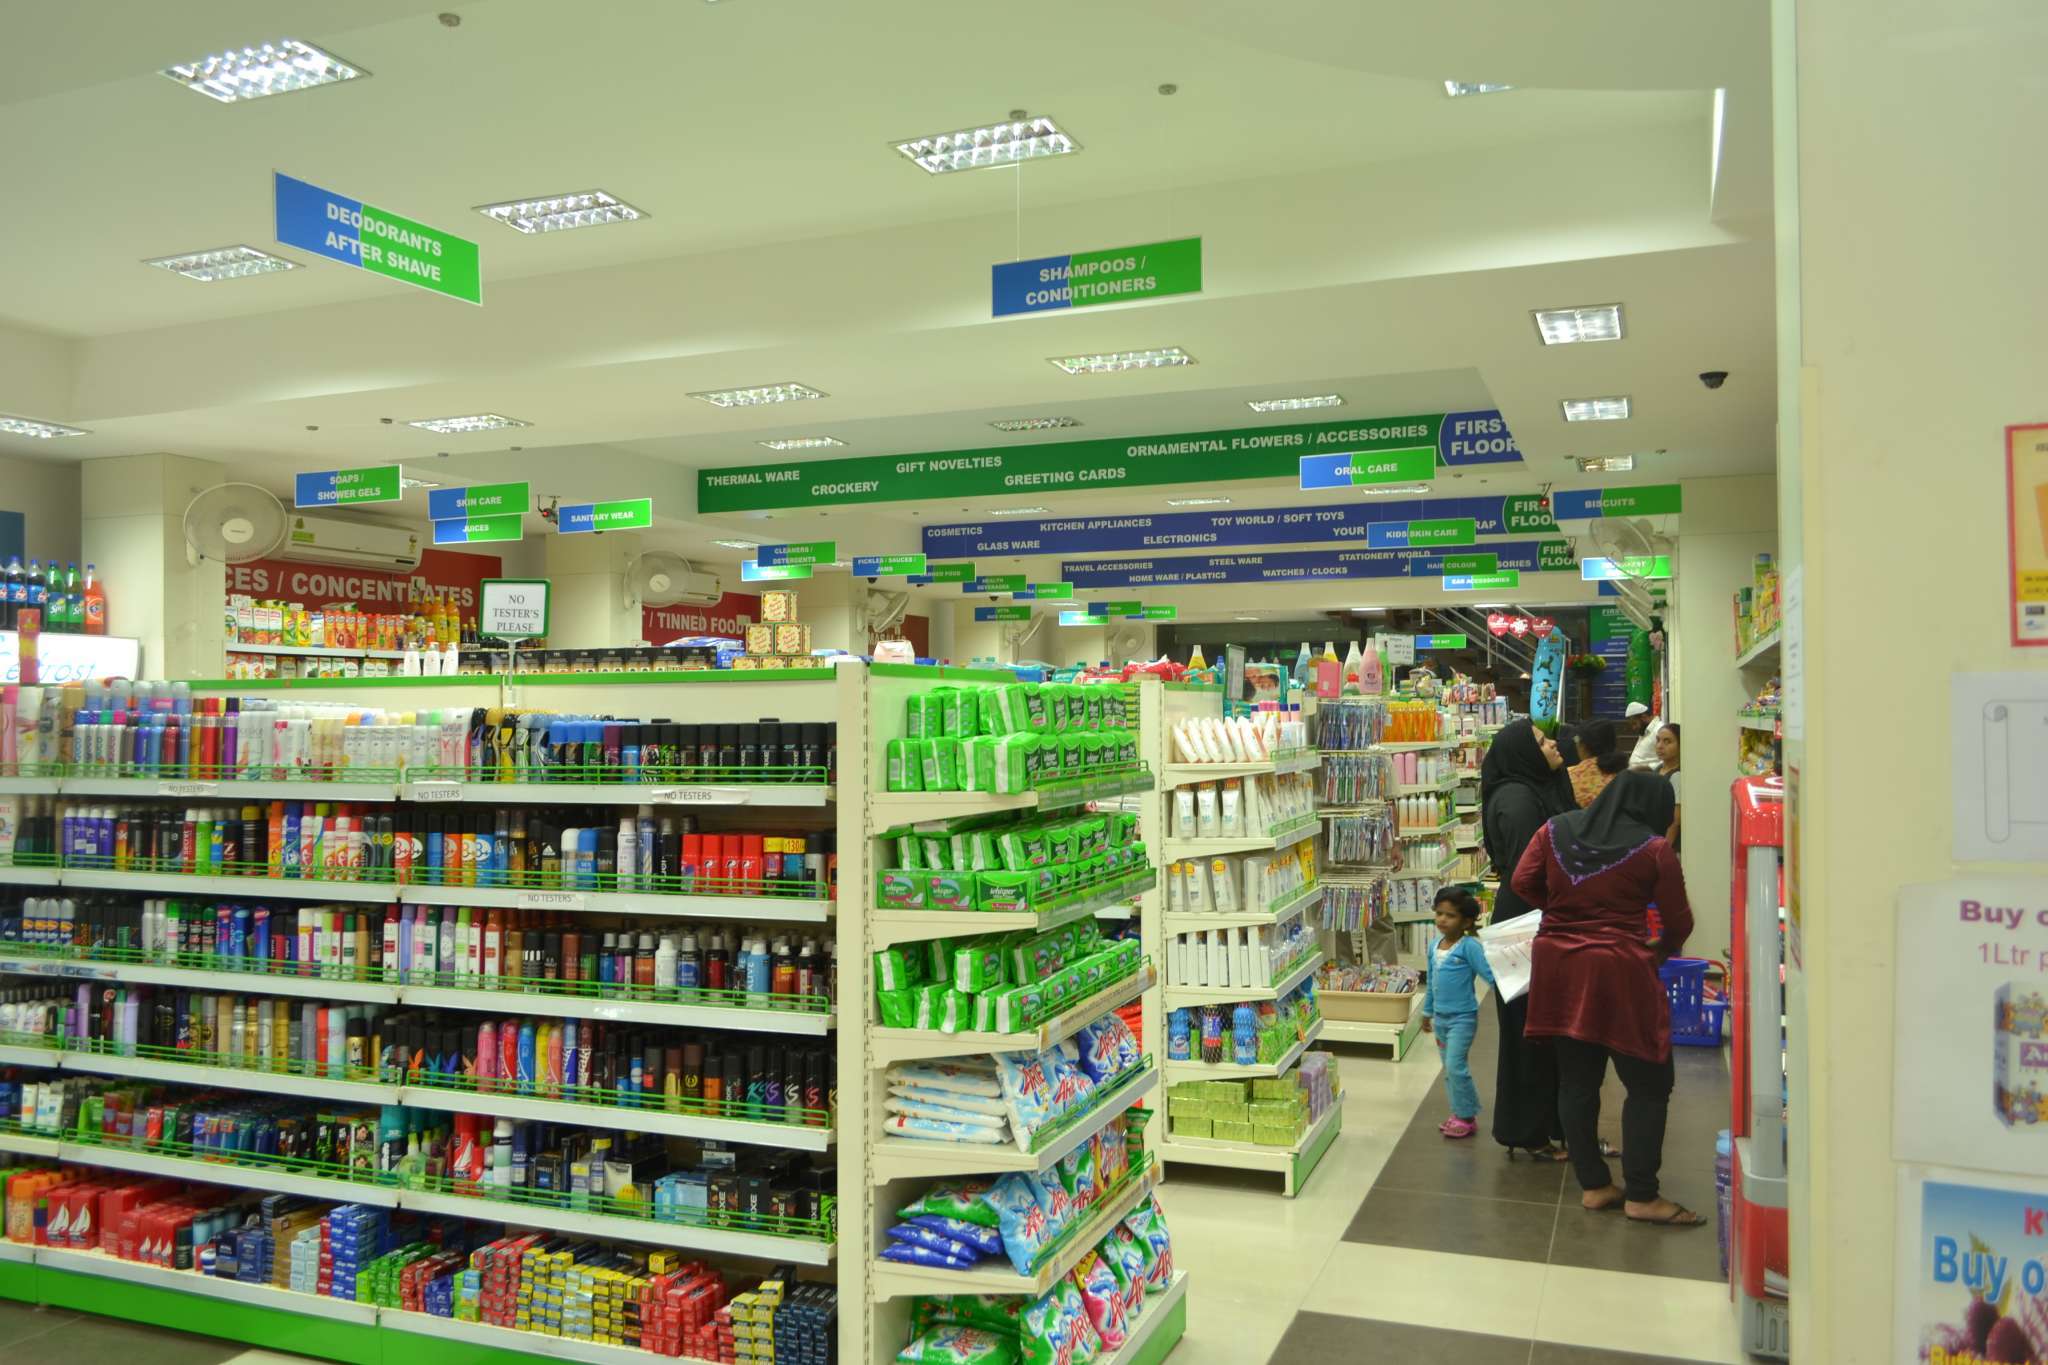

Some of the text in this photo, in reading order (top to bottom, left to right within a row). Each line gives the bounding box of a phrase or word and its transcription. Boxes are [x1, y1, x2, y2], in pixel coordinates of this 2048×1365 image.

[326, 202, 442, 257] DEODORANTS
[325, 231, 441, 282] AFTER SHAVE
[1039, 257, 1137, 282] SHAMPOOS
[1025, 276, 1157, 306] CONDITIONERS
[1455, 419, 1511, 436] FIRS
[1127, 440, 1227, 457] ORNAMENTAL
[1231, 433, 1304, 450] FLOWERS
[1316, 424, 1429, 445] ACCESSORIES
[896, 456, 1003, 474] GIFT NOVELTIES
[1334, 462, 1398, 477] ORAL CARE
[329, 474, 359, 485] SOAPS
[706, 469, 800, 487] THERMAL WARE
[1004, 467, 1127, 487] GREETING CARDS
[317, 487, 381, 501] SHOWER GELS
[811, 480, 880, 497] CROCKERY
[456, 496, 503, 508] SKIN CARE
[1584, 498, 1636, 509] BISCUITS
[571, 511, 634, 523] SANITARY WEAR
[1211, 516, 1235, 526] TOY
[1236, 513, 1275, 525] WORLD
[1283, 512, 1314, 523] SOFT
[1316, 510, 1345, 522] TOYS
[462, 523, 490, 533] JUICES
[927, 526, 983, 537] COSMETICS
[1040, 518, 1152, 532] KITCHEN APPLIANCES
[1333, 525, 1365, 537] YOUR
[1143, 533, 1217, 545] ELECTRONICS
[1386, 528, 1458, 539] KIDS SKIN CARE
[977, 539, 1041, 552] GLASS WARE
[1209, 556, 1263, 567] STEEL WARE
[1338, 549, 1431, 562] STATIONERY WORLD
[1063, 561, 1154, 573] TRAVEL ACCESSORIES
[1262, 569, 1303, 578] WATCHES
[1311, 566, 1348, 576] CLOCKS
[1128, 574, 1149, 583] HOME
[1151, 573, 1180, 582] WARE
[1186, 571, 1227, 581] PLASTICS
[291, 572, 475, 608] CONCENTRATES
[508, 594, 525, 605] NO
[492, 606, 540, 619] TESTER'S
[496, 621, 535, 633] PLEASE
[657, 612, 707, 632] TINNED
[417, 790, 460, 800] NO TESTERS
[665, 791, 712, 800] NO TESTERS
[528, 894, 572, 903] NO TESTERS
[1959, 899, 2024, 929] Buy
[1977, 942, 2031, 967] 1Ltr
[1933, 1234, 2009, 1304] Buy
